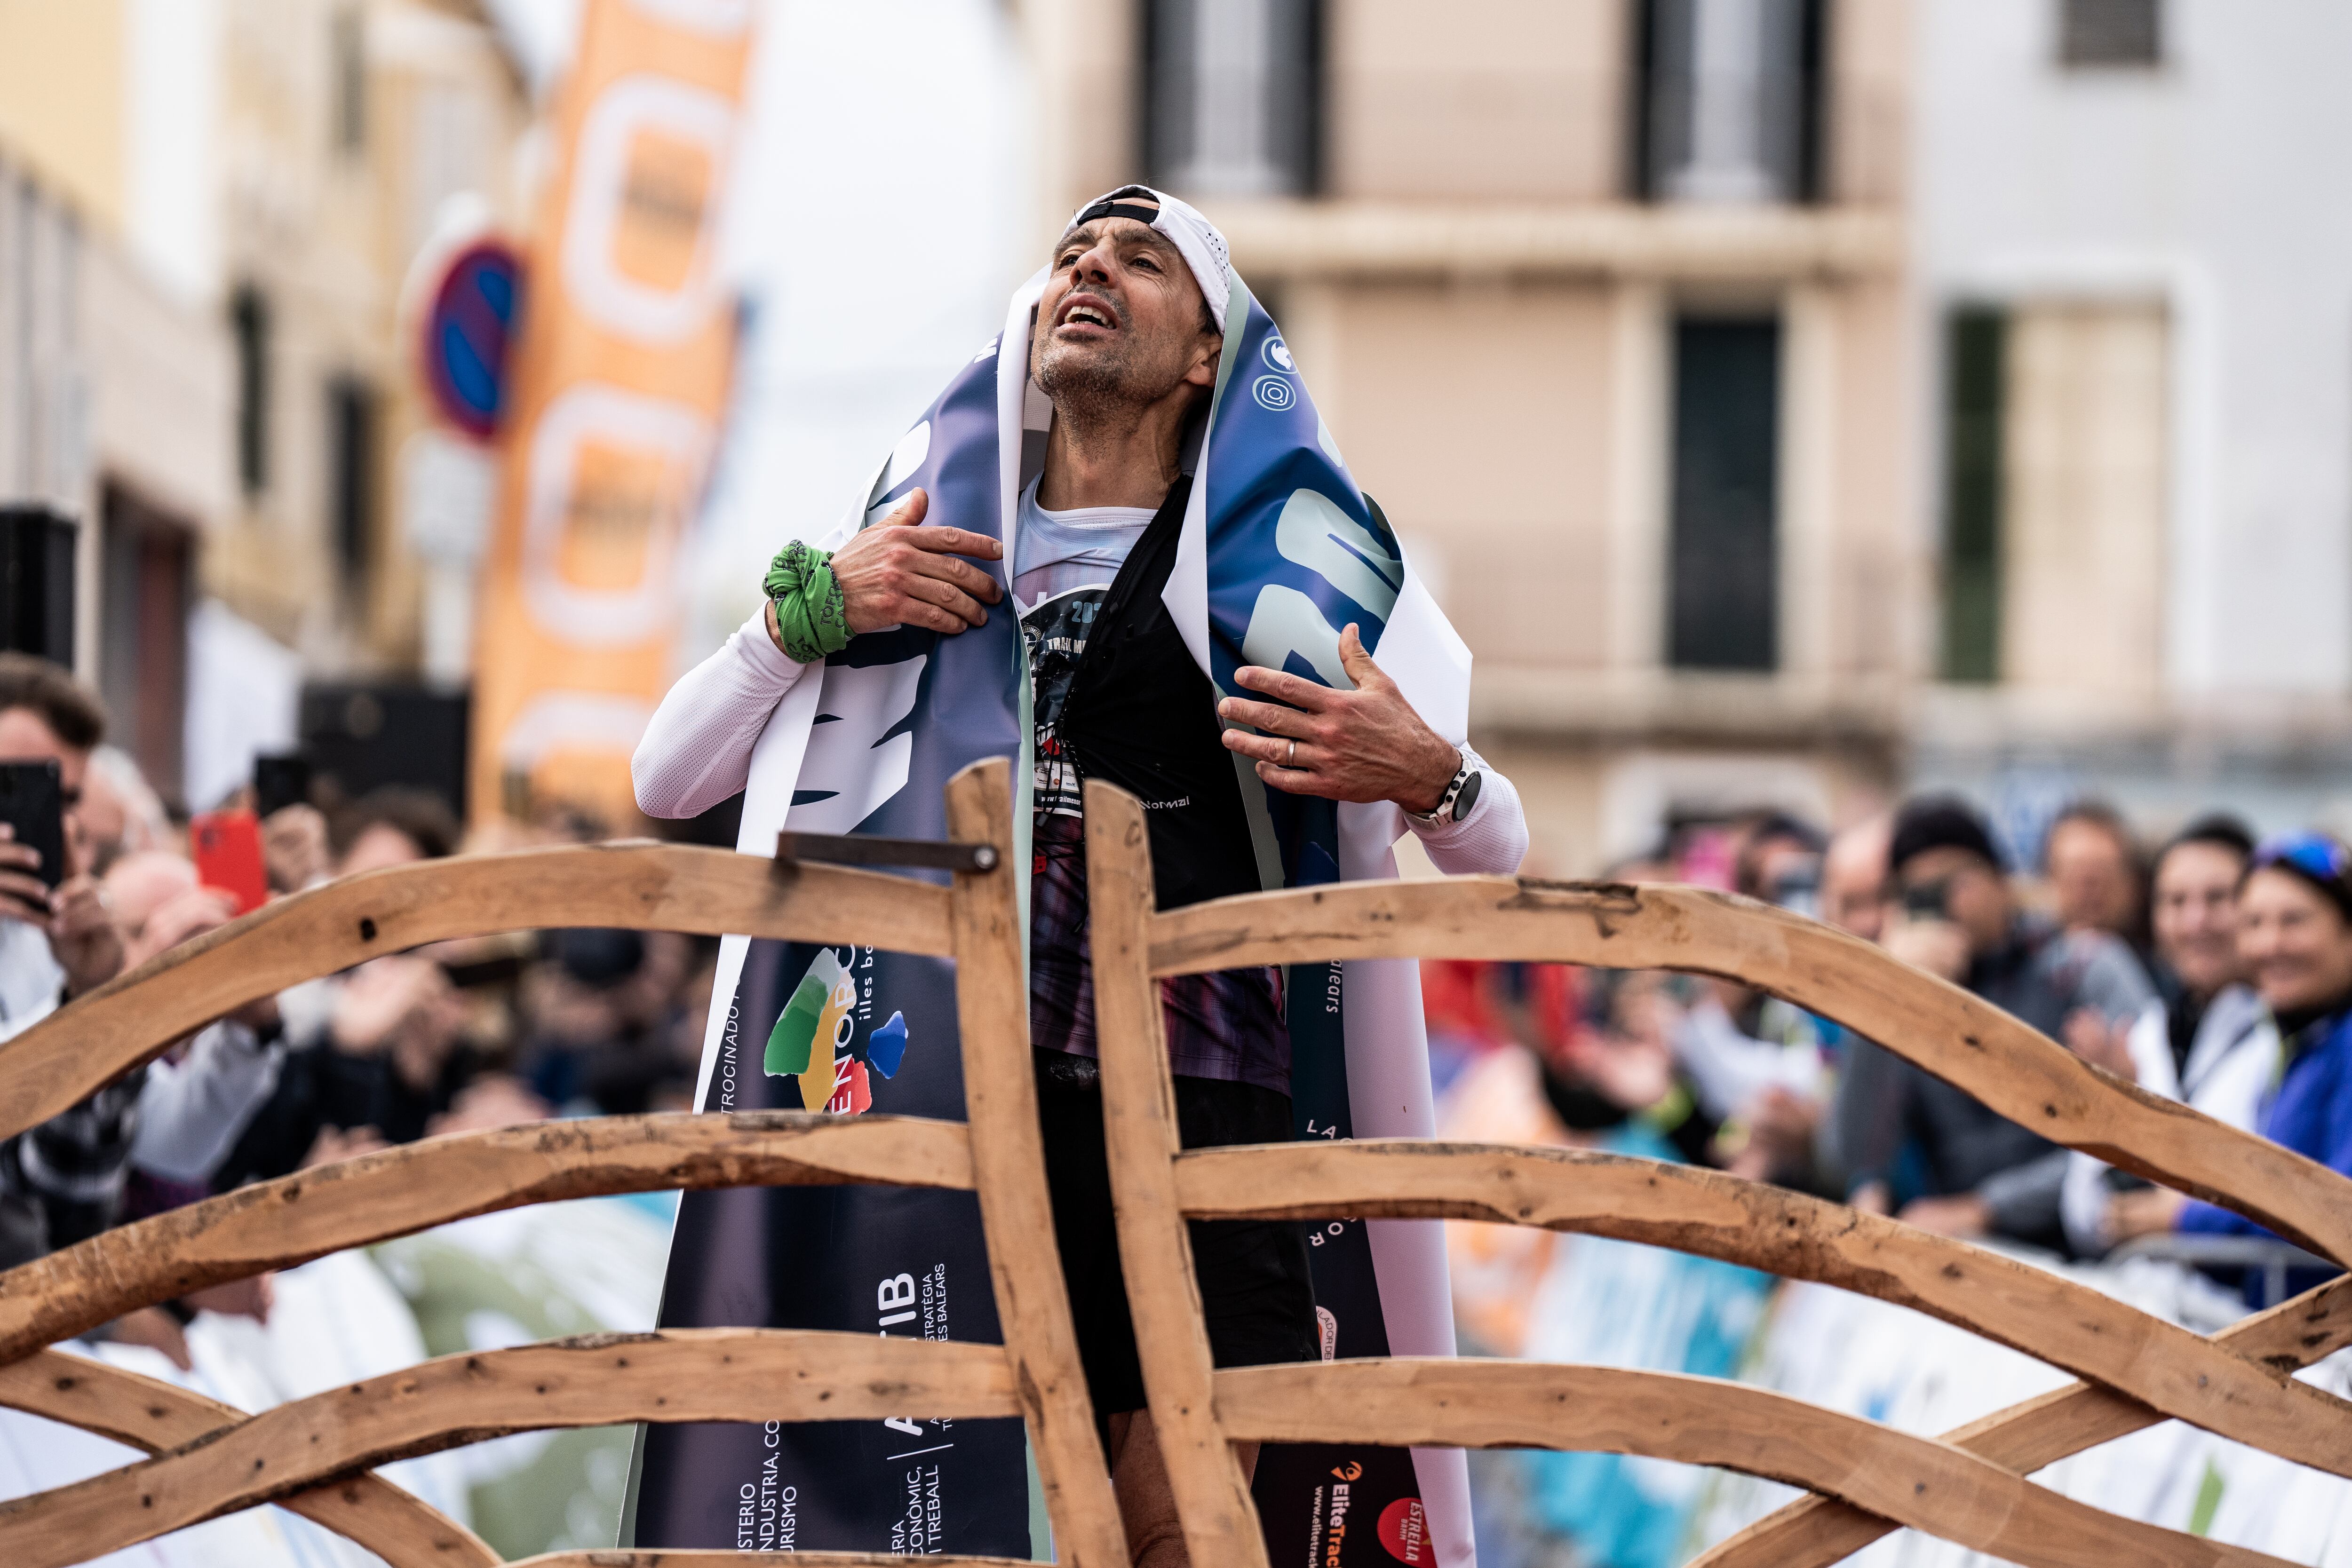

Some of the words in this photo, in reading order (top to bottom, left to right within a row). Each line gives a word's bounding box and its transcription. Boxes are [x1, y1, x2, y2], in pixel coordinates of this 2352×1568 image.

[1047, 637, 1072, 652] TRAIL
[859, 976, 873, 1021] illes
[1326, 958, 1343, 1013] alears
[721, 1006, 739, 1116] TROCINADO
[935, 1263, 947, 1323] BALEARS
[738, 1483, 755, 1552] ISTERIO
[759, 1452, 780, 1552] NDUSTRIA,
[925, 1465, 941, 1545] TREBALL
[1326, 1484, 1351, 1568] EliteTrac
[1406, 1502, 1422, 1561] ESTRELLA
